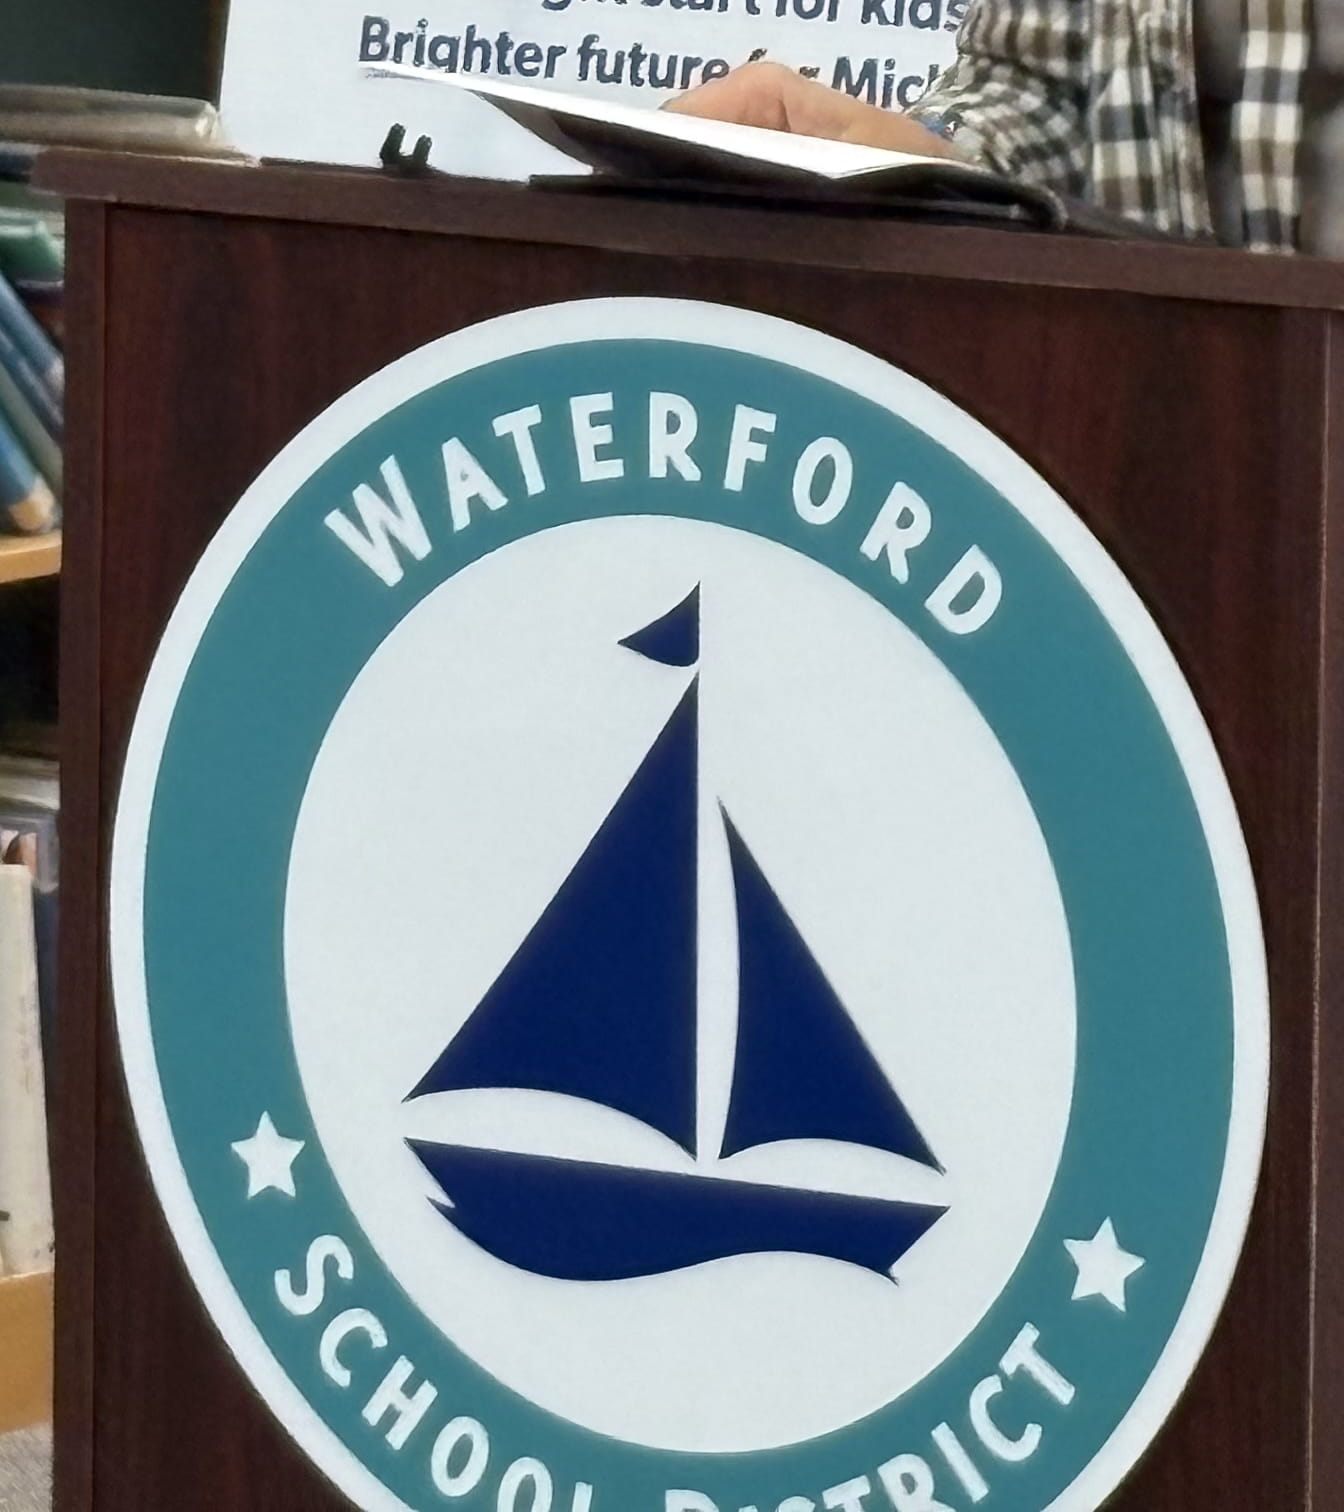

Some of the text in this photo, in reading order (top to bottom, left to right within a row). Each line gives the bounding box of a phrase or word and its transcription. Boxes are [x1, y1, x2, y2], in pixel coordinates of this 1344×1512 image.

[358, 14, 567, 79] Brighter
[577, 33, 730, 90] future
[324, 390, 1003, 636] WATERFORD
